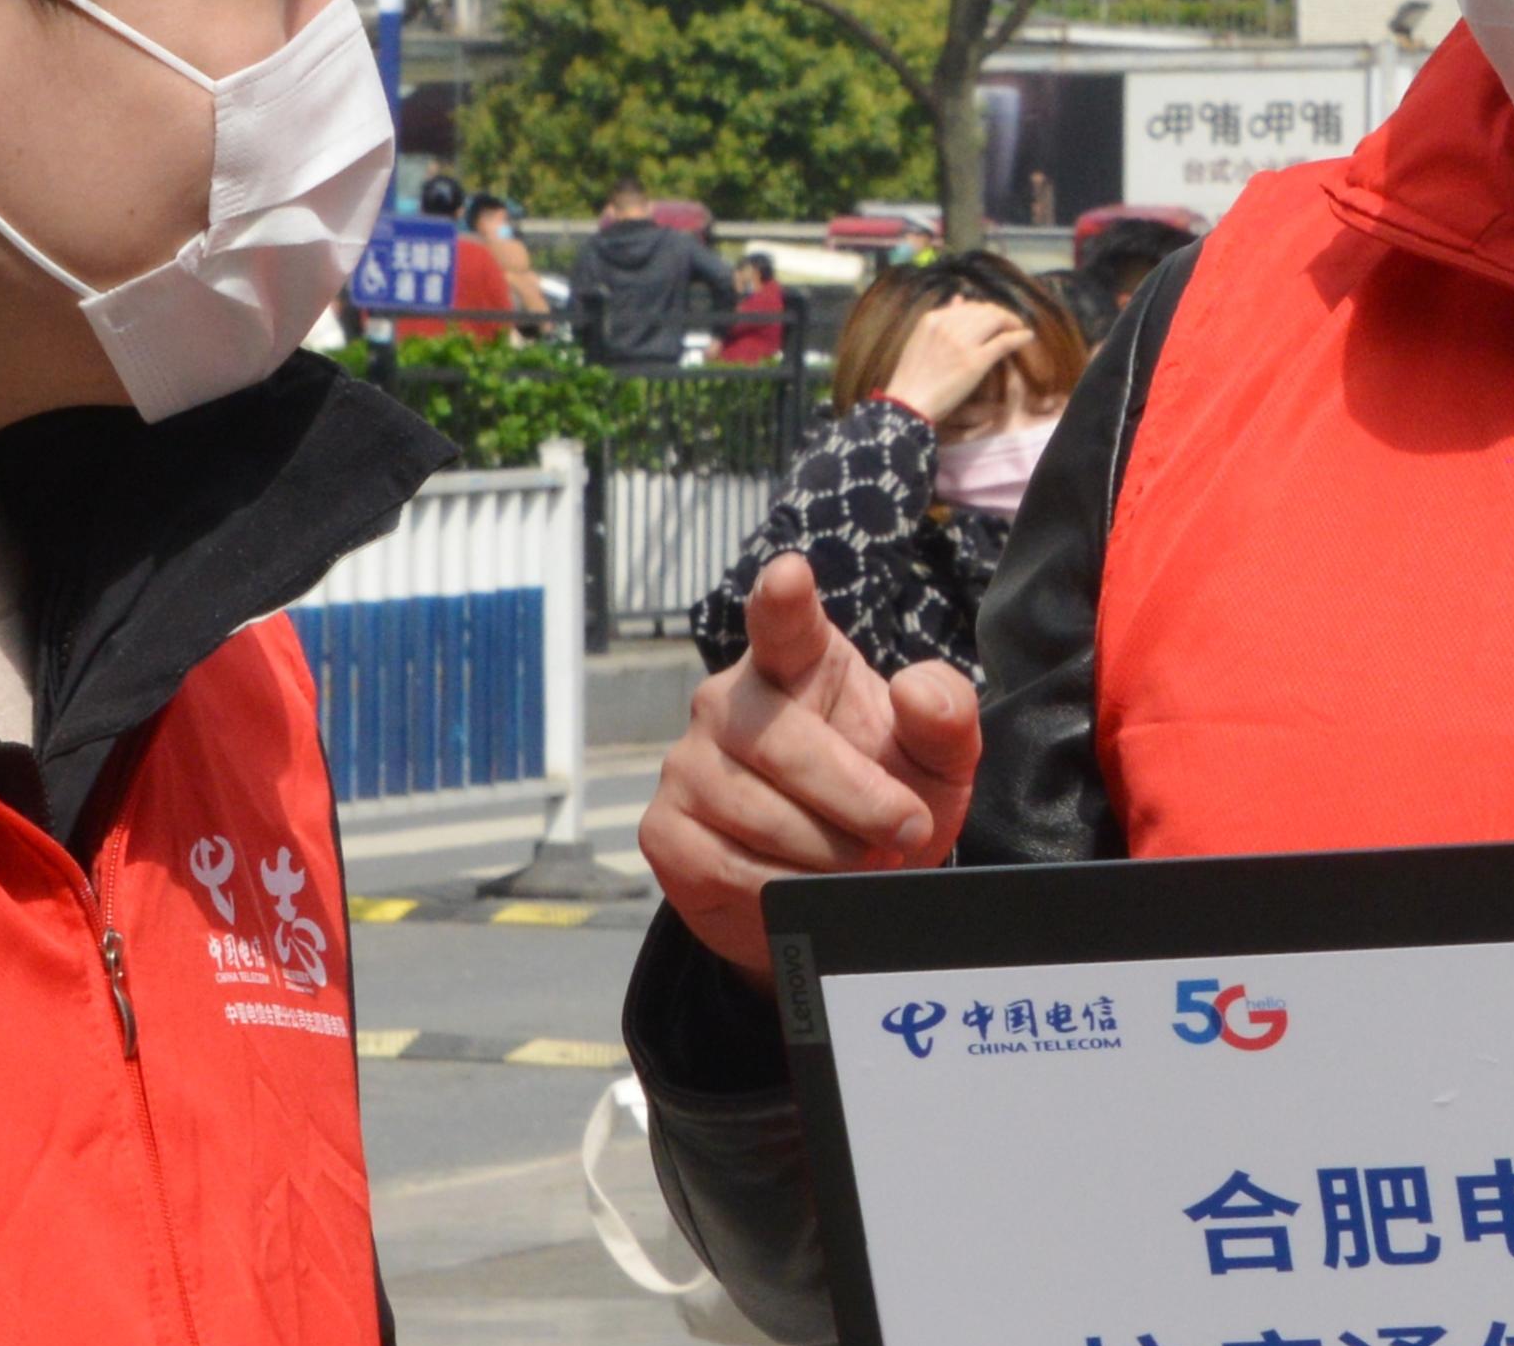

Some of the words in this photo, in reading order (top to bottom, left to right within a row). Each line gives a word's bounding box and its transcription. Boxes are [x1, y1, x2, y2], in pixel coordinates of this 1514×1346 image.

[786, 943, 815, 1037] Lenovo
[962, 995, 1118, 1040] 中国电信
[1172, 979, 1288, 1051] 5G
[967, 1042, 1028, 1056] CHINA
[1032, 1037, 1122, 1052] TELECOM
